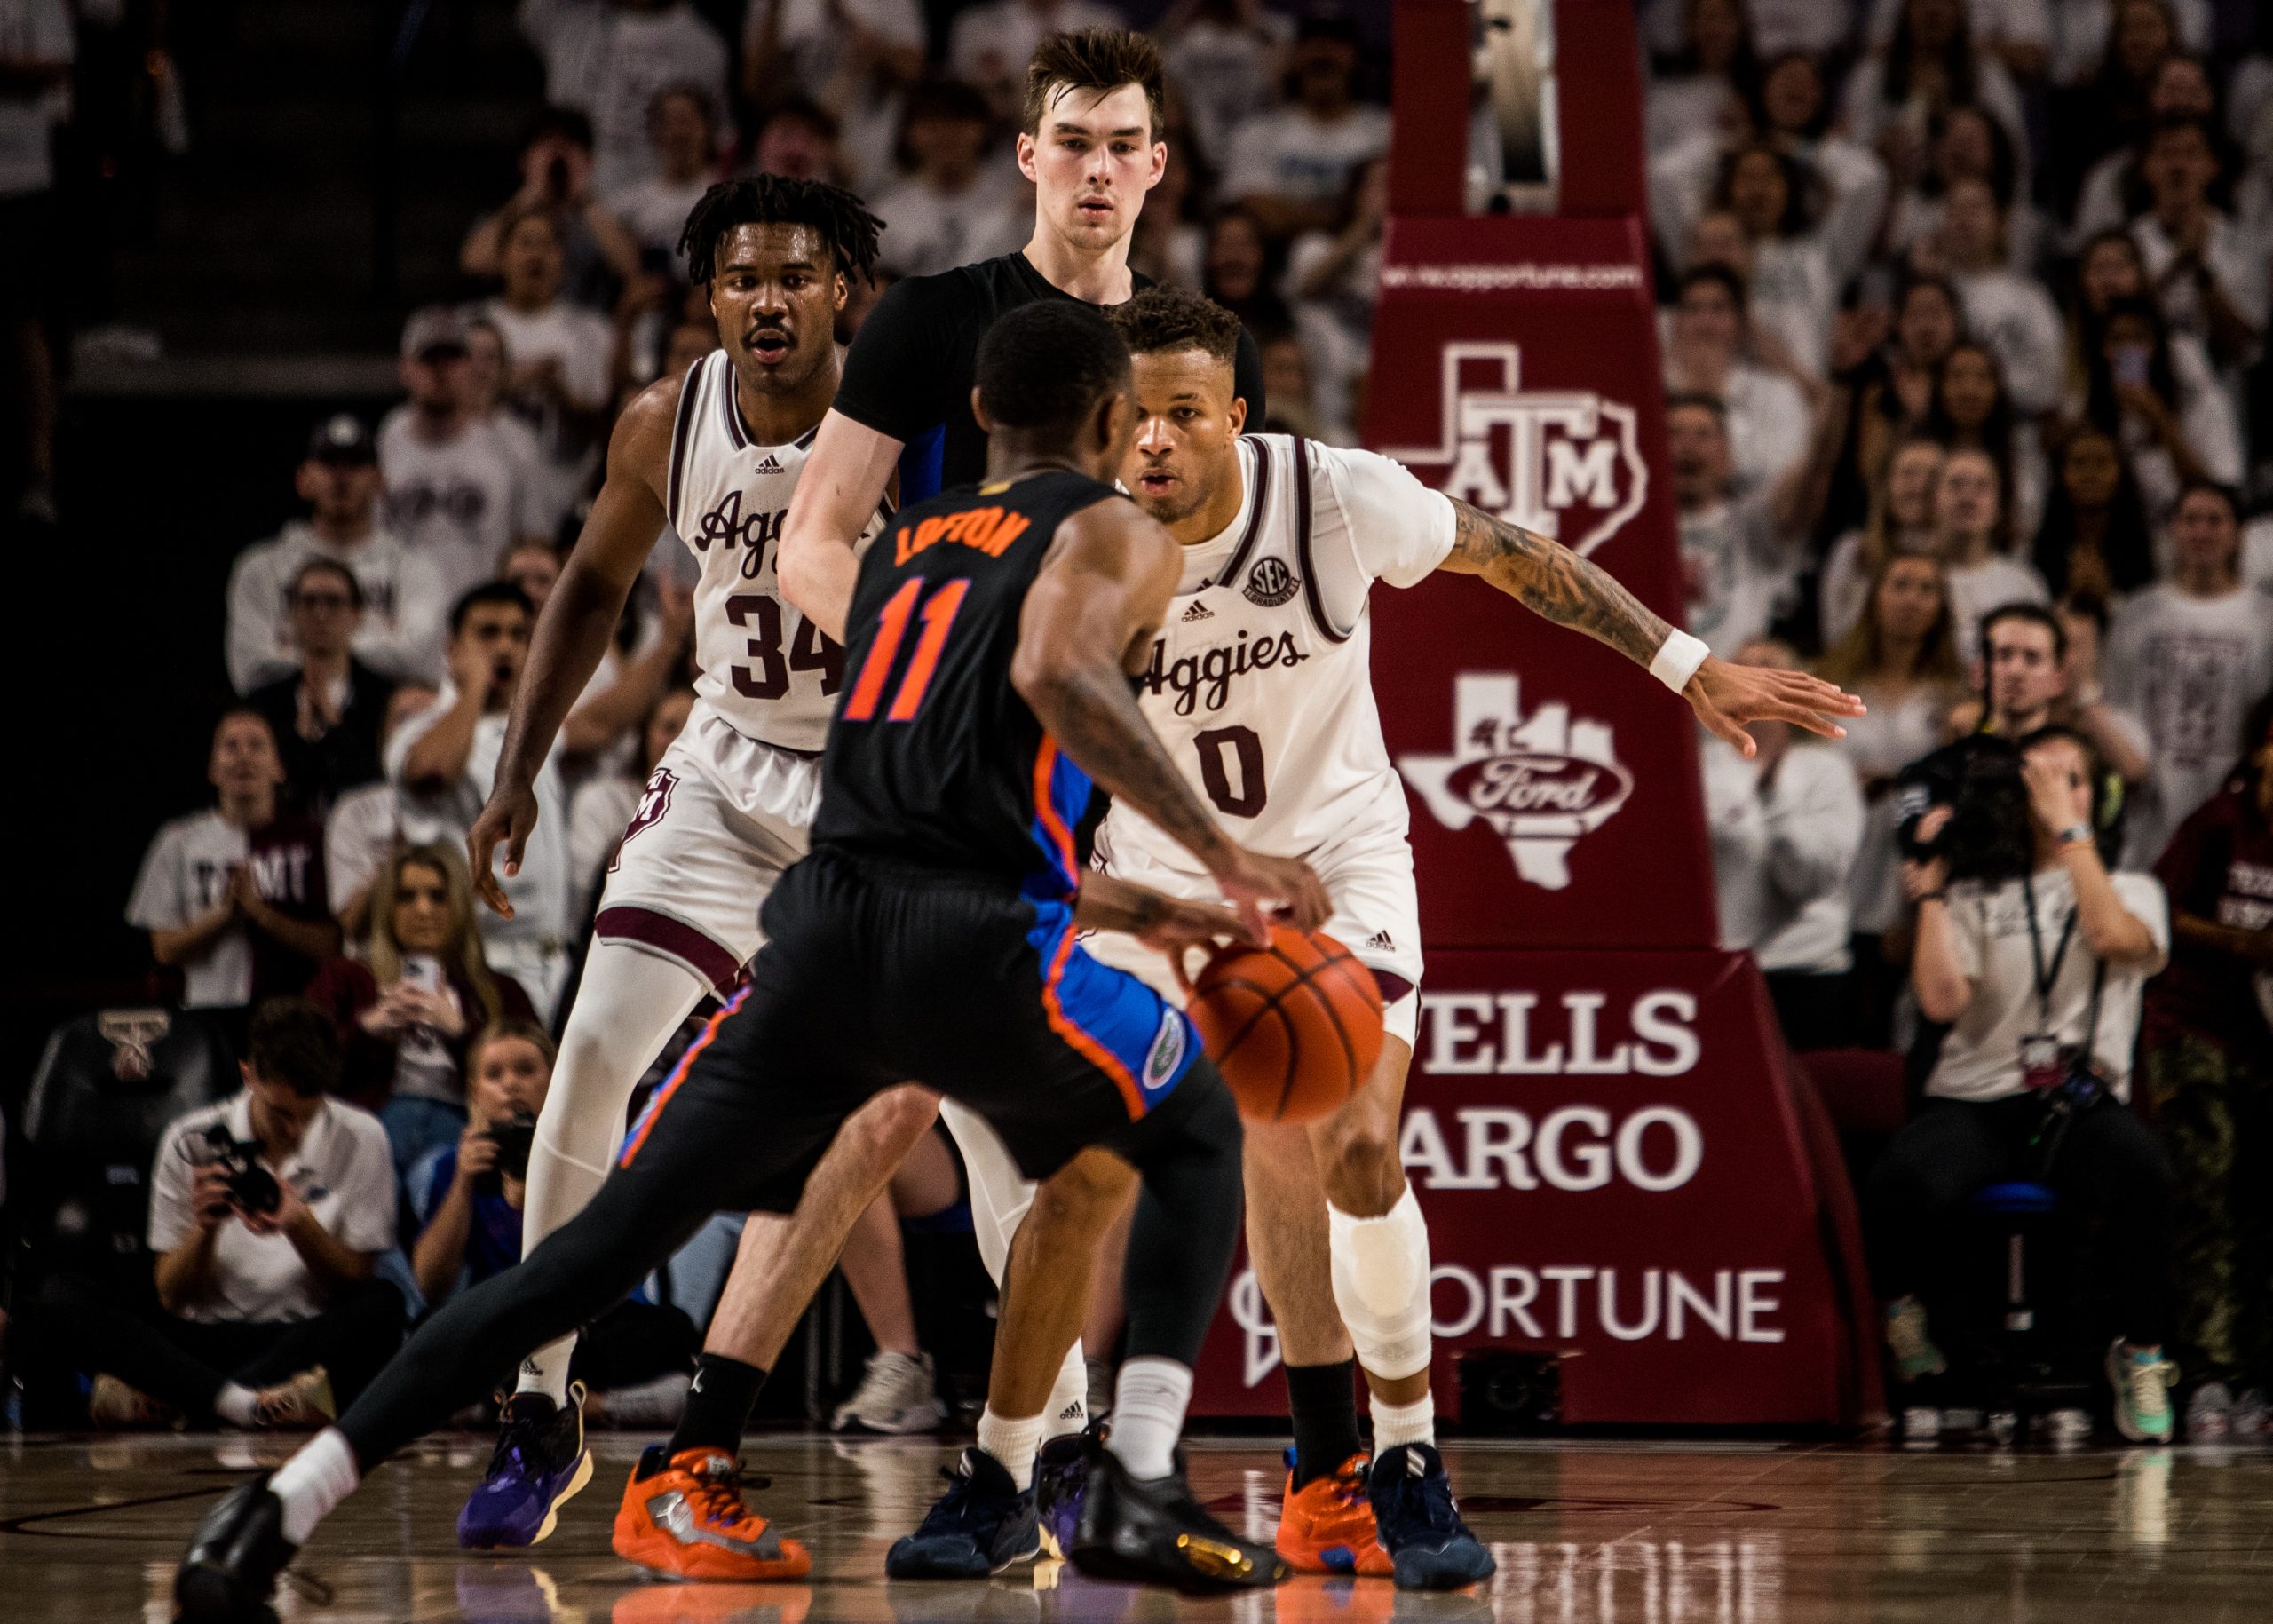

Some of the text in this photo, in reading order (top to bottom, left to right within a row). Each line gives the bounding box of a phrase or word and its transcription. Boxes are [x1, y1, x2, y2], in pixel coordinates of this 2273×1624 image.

[755, 463, 785, 475] adidas
[894, 504, 1032, 568] LOFTON
[1252, 558, 1288, 597] SEC
[1181, 610, 1215, 622] adidas
[842, 575, 973, 723] 11
[1192, 725, 1267, 819] 0
[1468, 757, 1600, 810] Ford
[1421, 987, 1703, 1078] ELLS
[1398, 1104, 1706, 1192] ARGO
